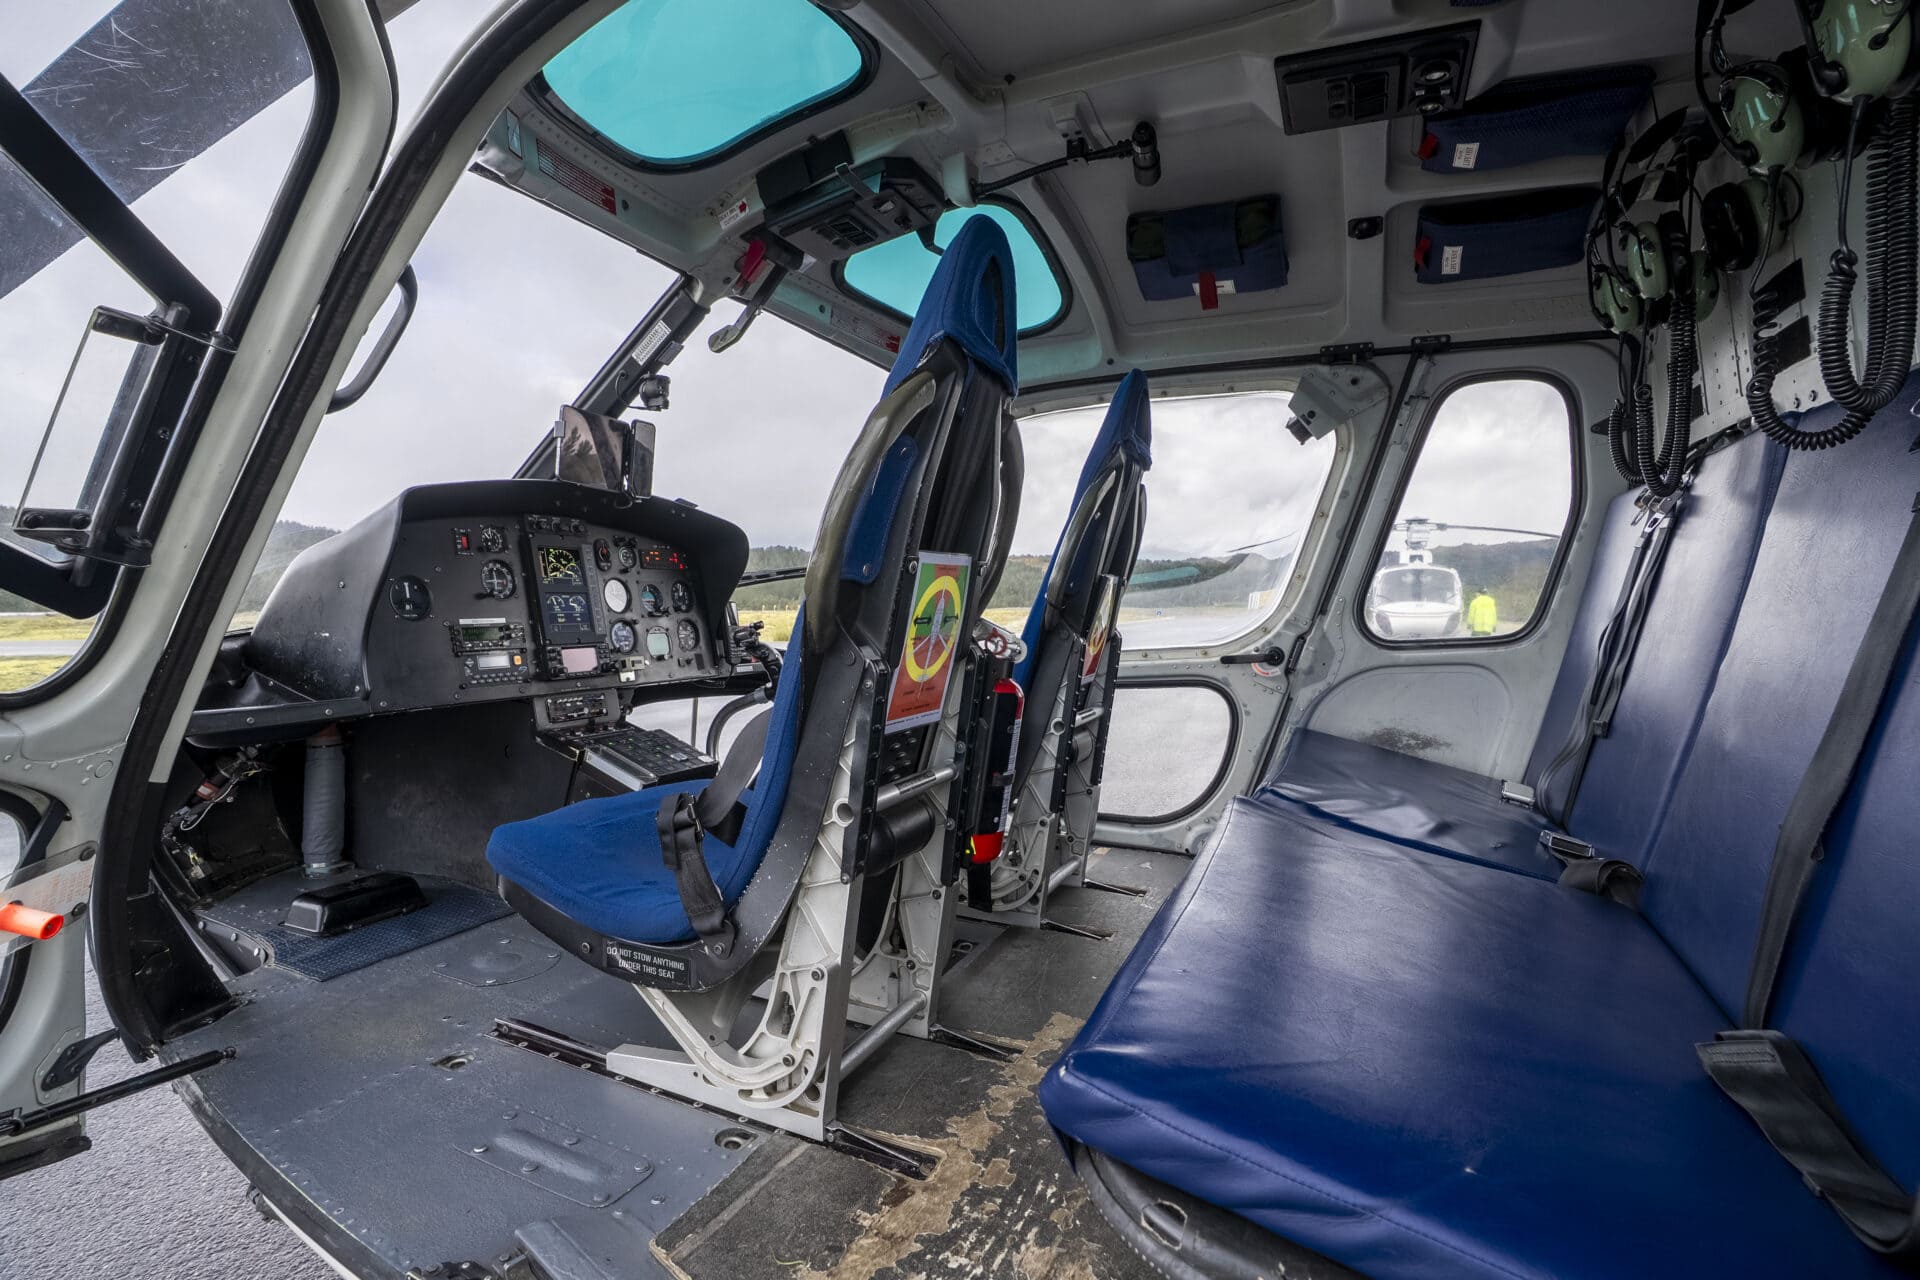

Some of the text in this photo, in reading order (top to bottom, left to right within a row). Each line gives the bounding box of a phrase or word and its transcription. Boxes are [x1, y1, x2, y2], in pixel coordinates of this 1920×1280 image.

[606, 946, 684, 970] DO NOT STOW ANYTHING
[619, 958, 675, 979] UNDER THIS SEAT
